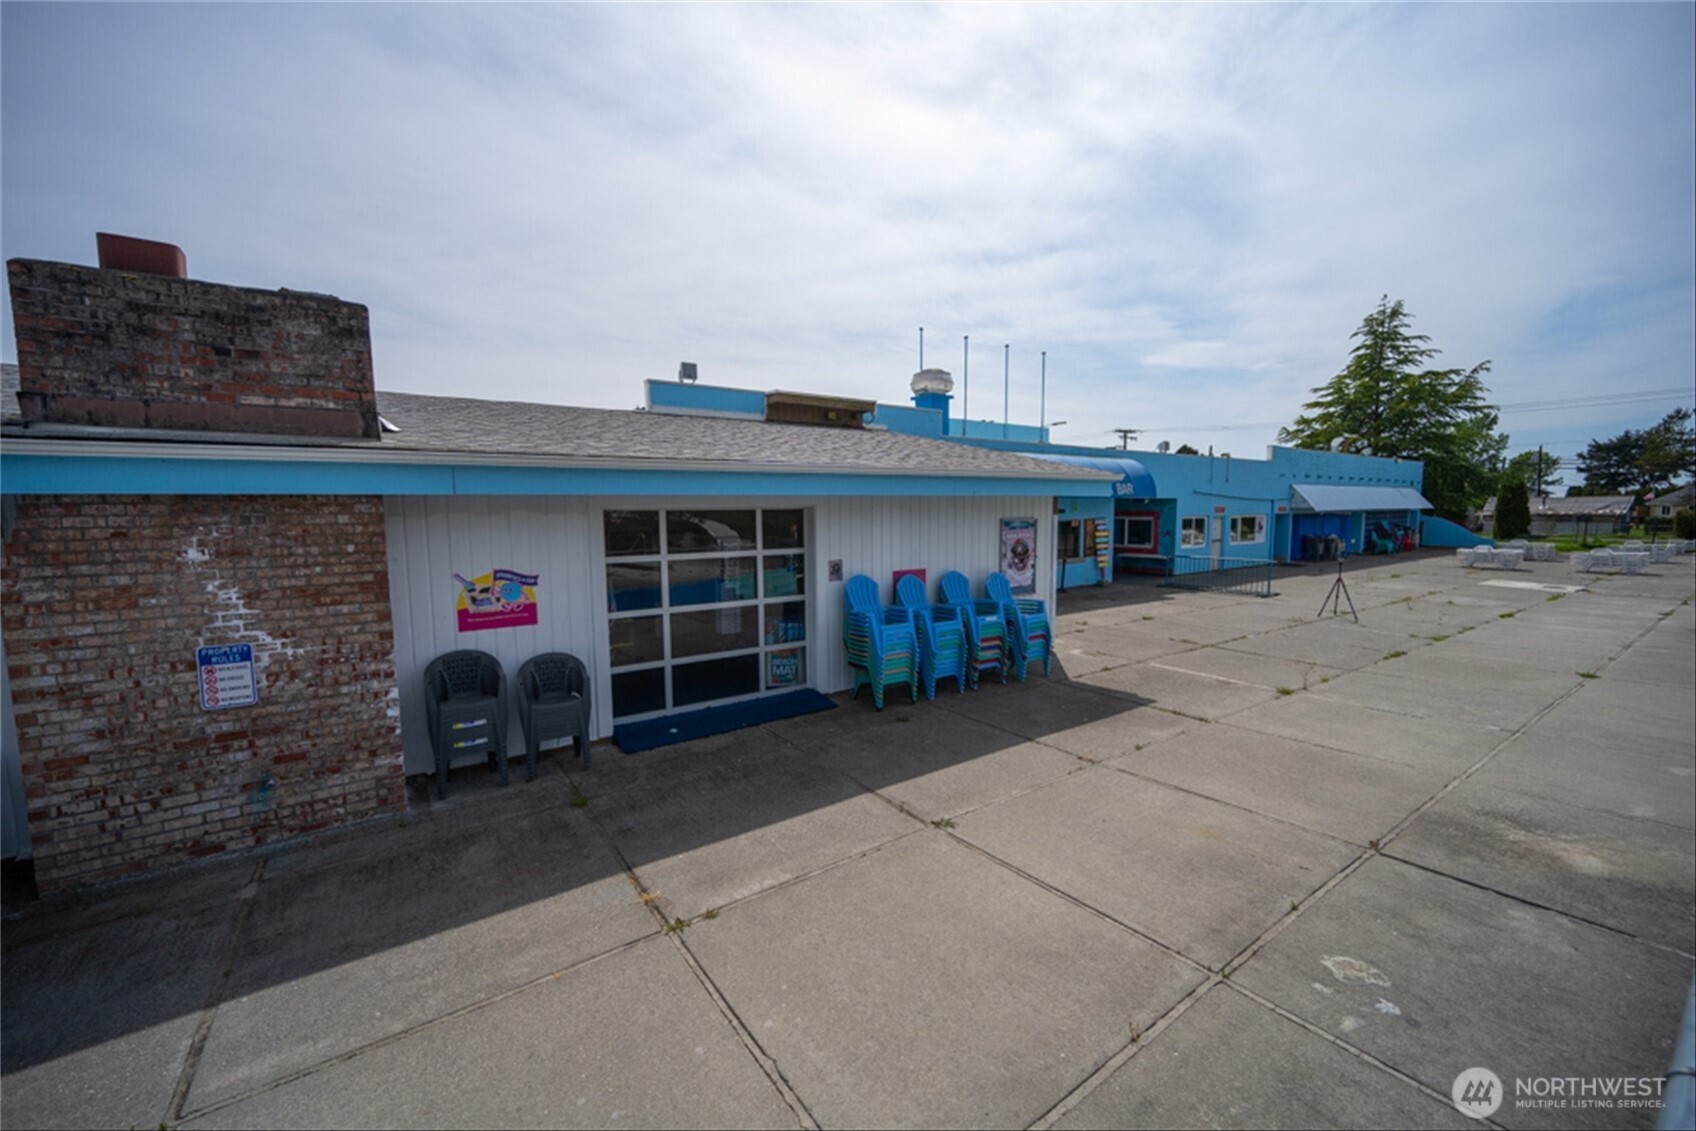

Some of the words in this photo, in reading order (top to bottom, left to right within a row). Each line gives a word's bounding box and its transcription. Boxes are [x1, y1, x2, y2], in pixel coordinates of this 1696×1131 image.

[1115, 483, 1135, 495] BAR
[201, 646, 248, 656] PROPERTY
[211, 654, 241, 663] RULES
[772, 665, 798, 676] MAT
